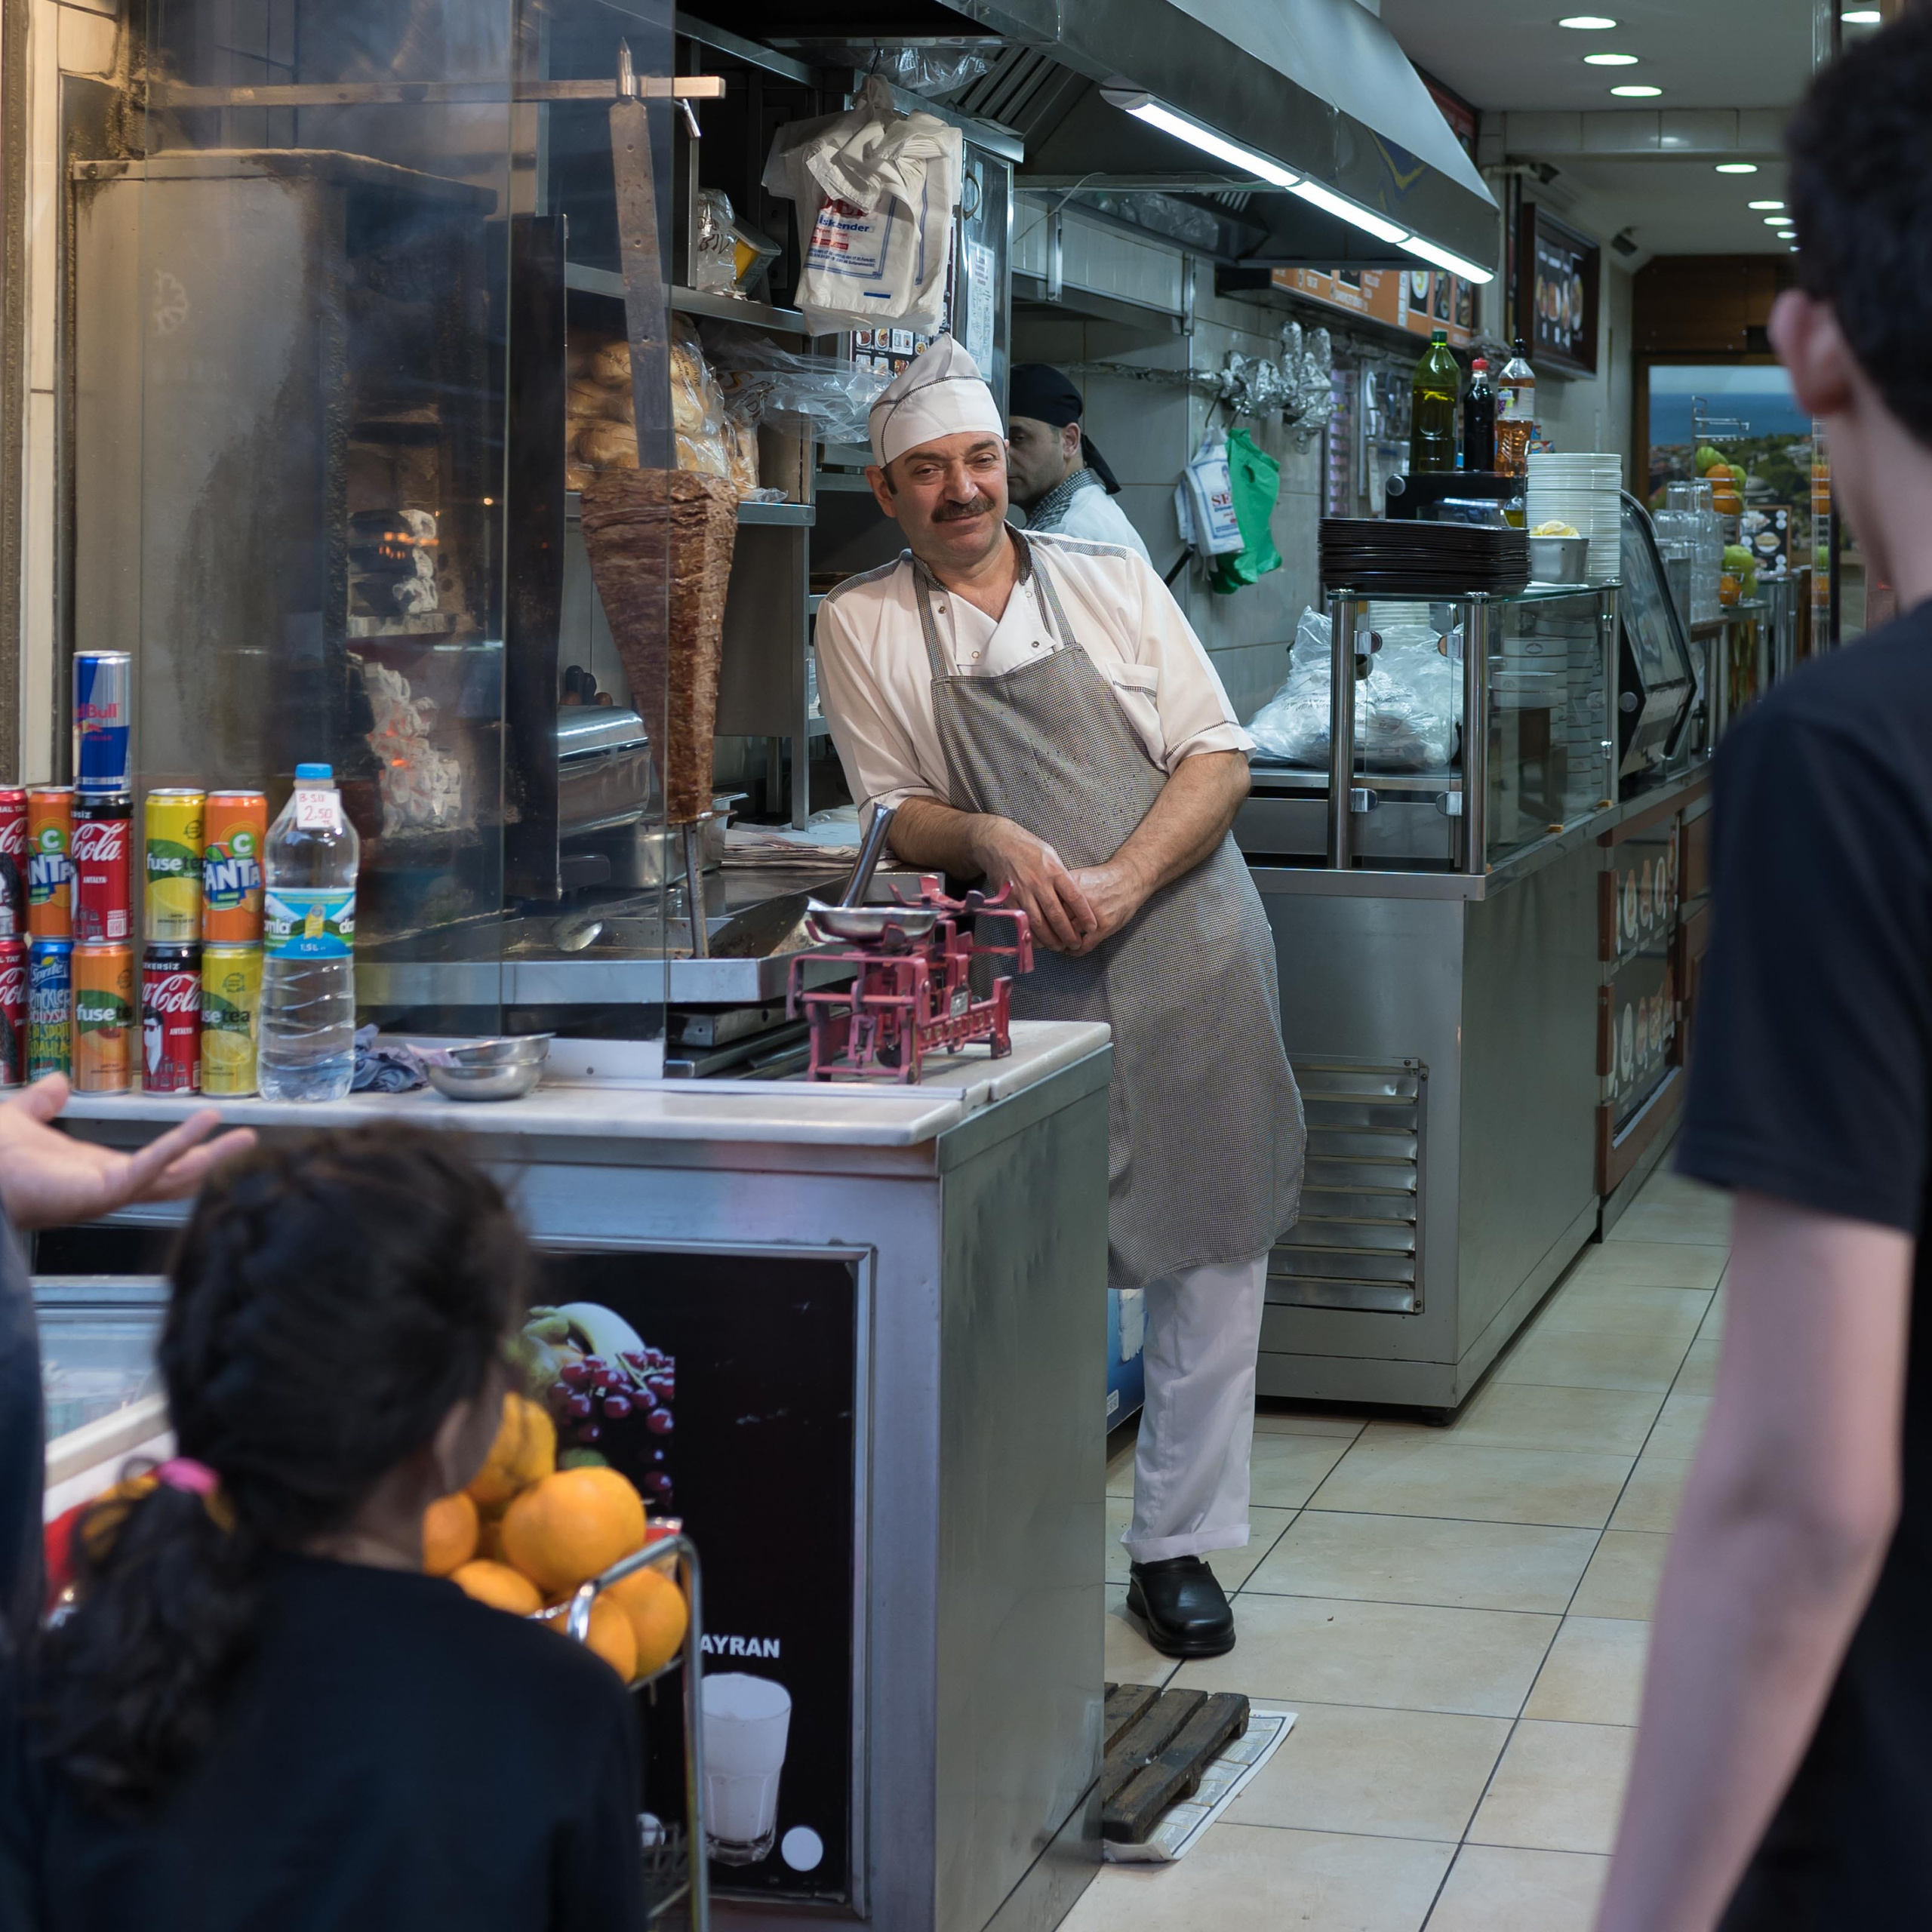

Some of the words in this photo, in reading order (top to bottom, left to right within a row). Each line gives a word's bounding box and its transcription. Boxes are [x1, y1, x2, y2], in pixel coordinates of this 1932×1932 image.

[87, 703, 117, 718] Bull
[42, 829, 60, 849] C
[233, 833, 251, 853] C
[32, 964, 63, 982] Sprite
[700, 1633, 780, 1658] AYRAN
